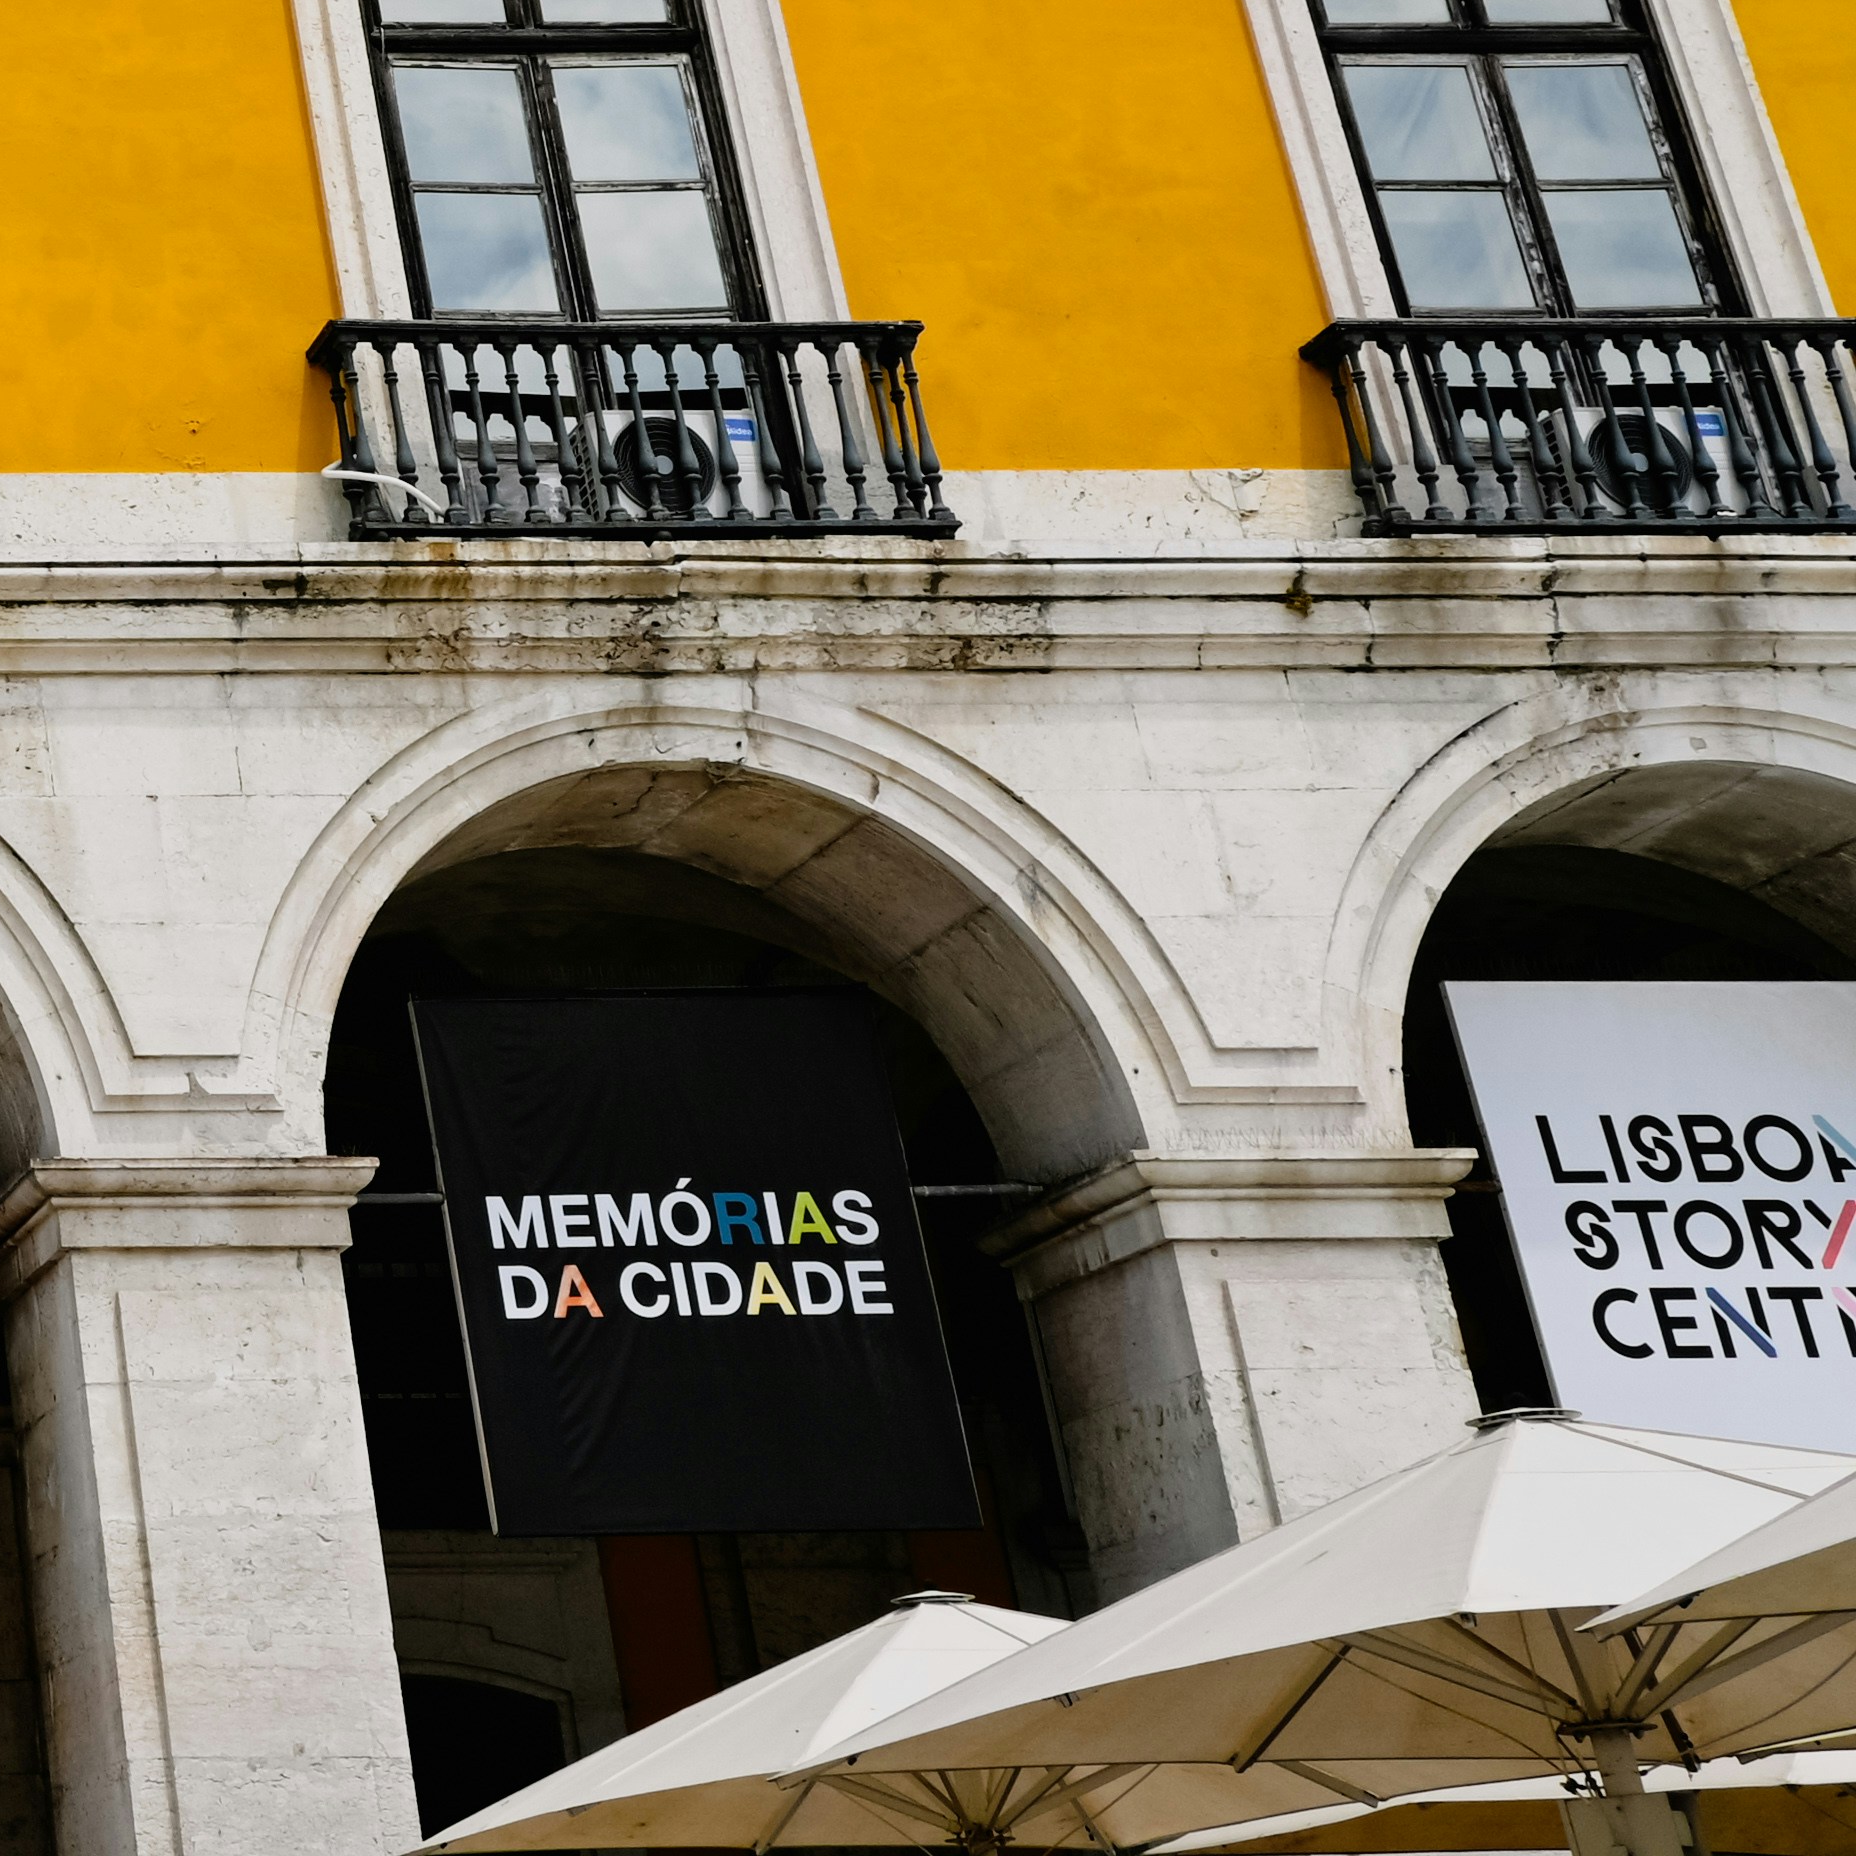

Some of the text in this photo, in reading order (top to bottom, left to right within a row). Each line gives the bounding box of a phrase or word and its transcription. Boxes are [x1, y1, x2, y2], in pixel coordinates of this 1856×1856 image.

[484, 1177, 880, 1250] MEMÓRIAS
[1564, 1199, 1856, 1271] STORY
[497, 1260, 895, 1320] DA CIDADE
